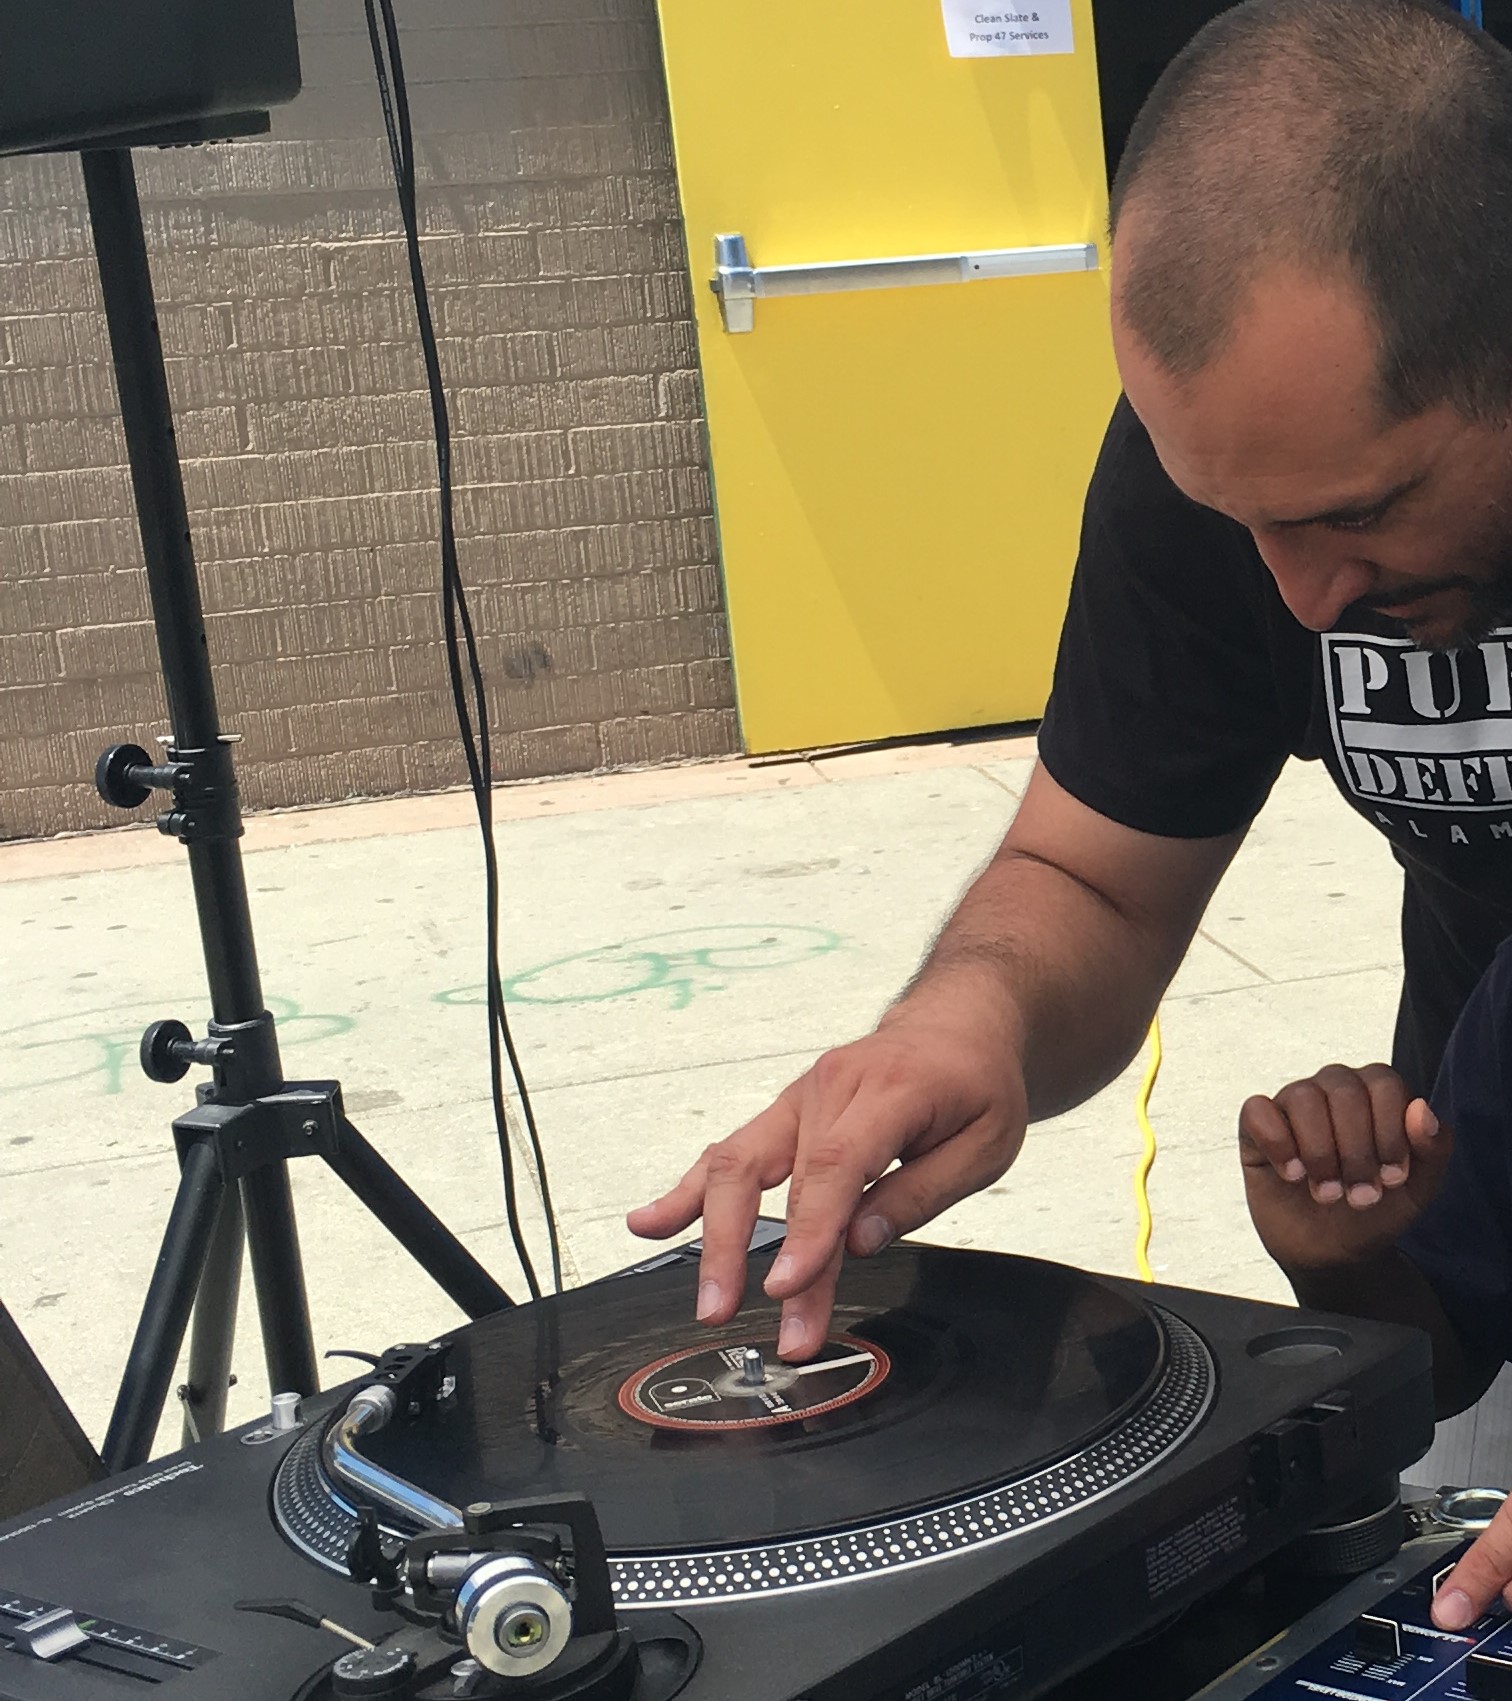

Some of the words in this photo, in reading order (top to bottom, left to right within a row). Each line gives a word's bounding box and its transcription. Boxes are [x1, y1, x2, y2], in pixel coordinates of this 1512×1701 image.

[975, 14, 1001, 24] Clean
[1004, 13, 1029, 23] Slate
[1032, 12, 1040, 22] &
[969, 33, 992, 43] Prop
[995, 31, 1006, 41] 47
[1009, 30, 1049, 41] Services
